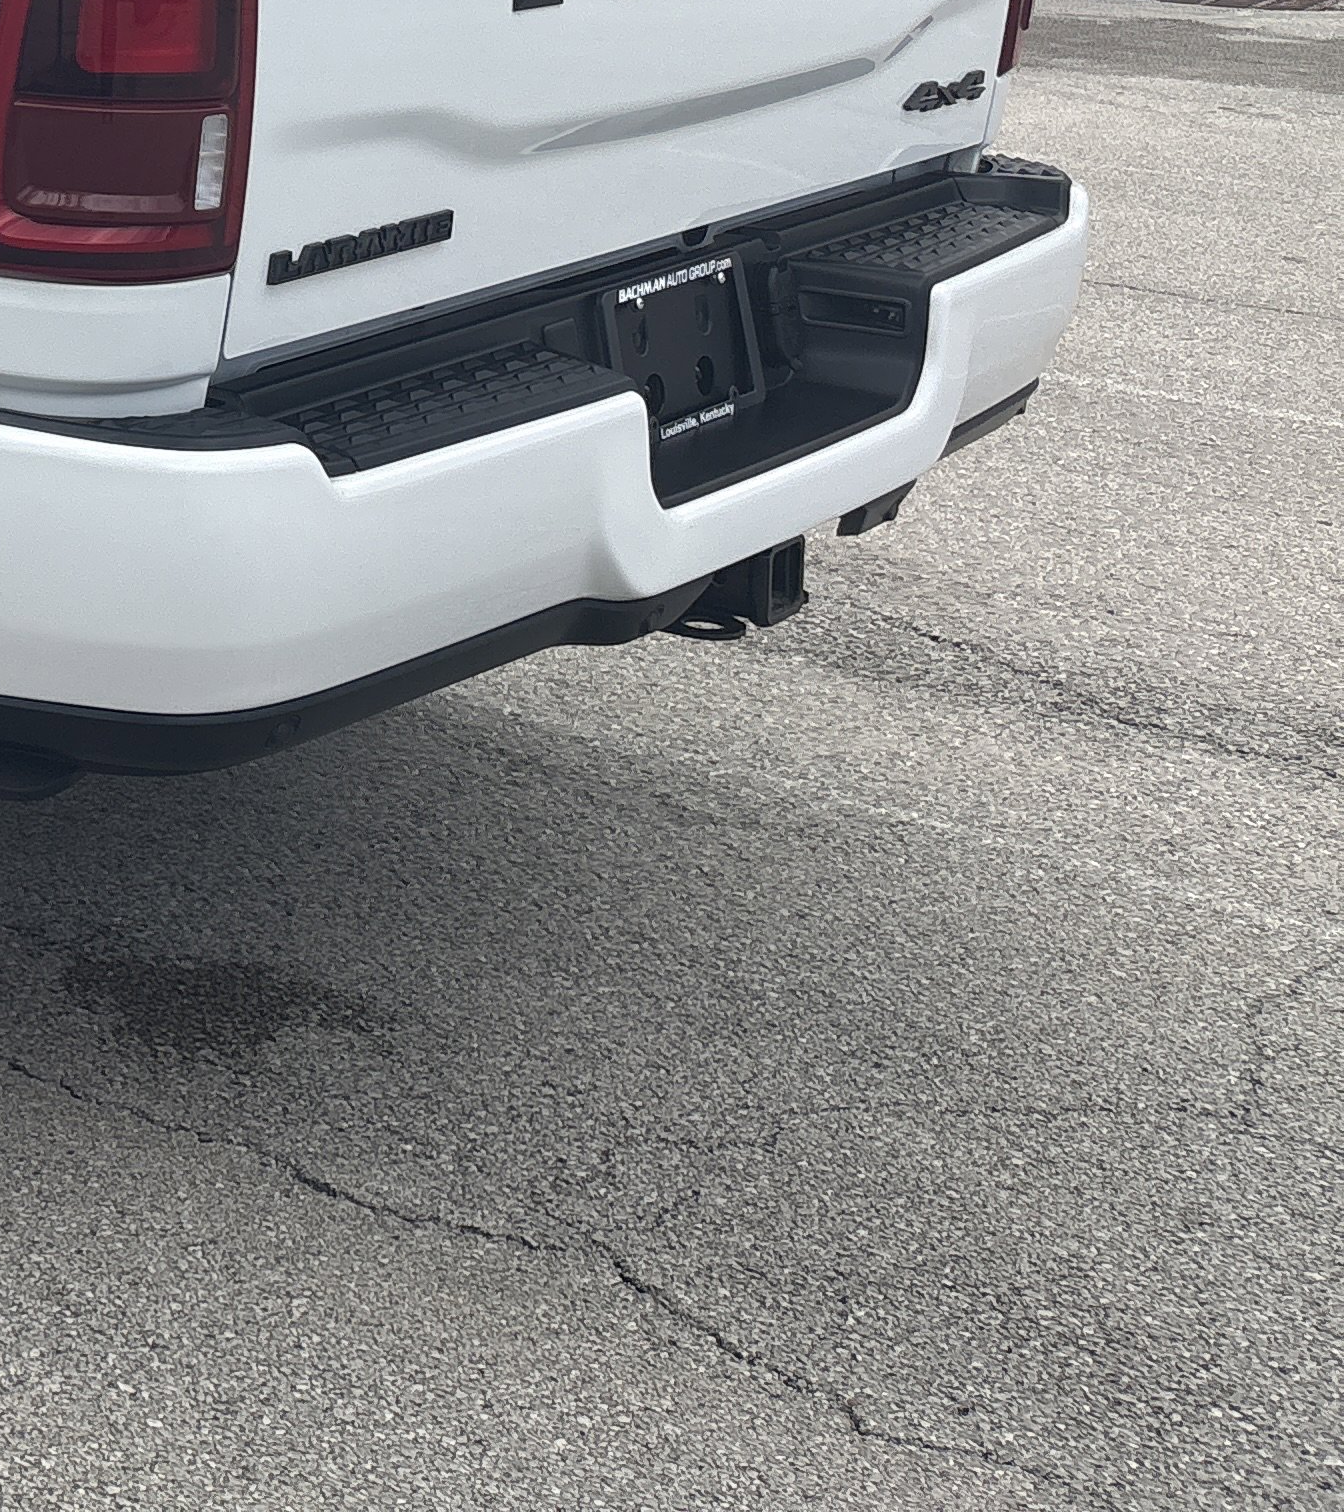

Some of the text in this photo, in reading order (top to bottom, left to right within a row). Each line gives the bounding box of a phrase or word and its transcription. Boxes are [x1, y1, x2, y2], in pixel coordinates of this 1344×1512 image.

[266, 208, 454, 286] LARAMIE
[618, 275, 666, 304] BACHMAN
[666, 268, 688, 288] AUTO
[699, 402, 735, 424] Kentucky
